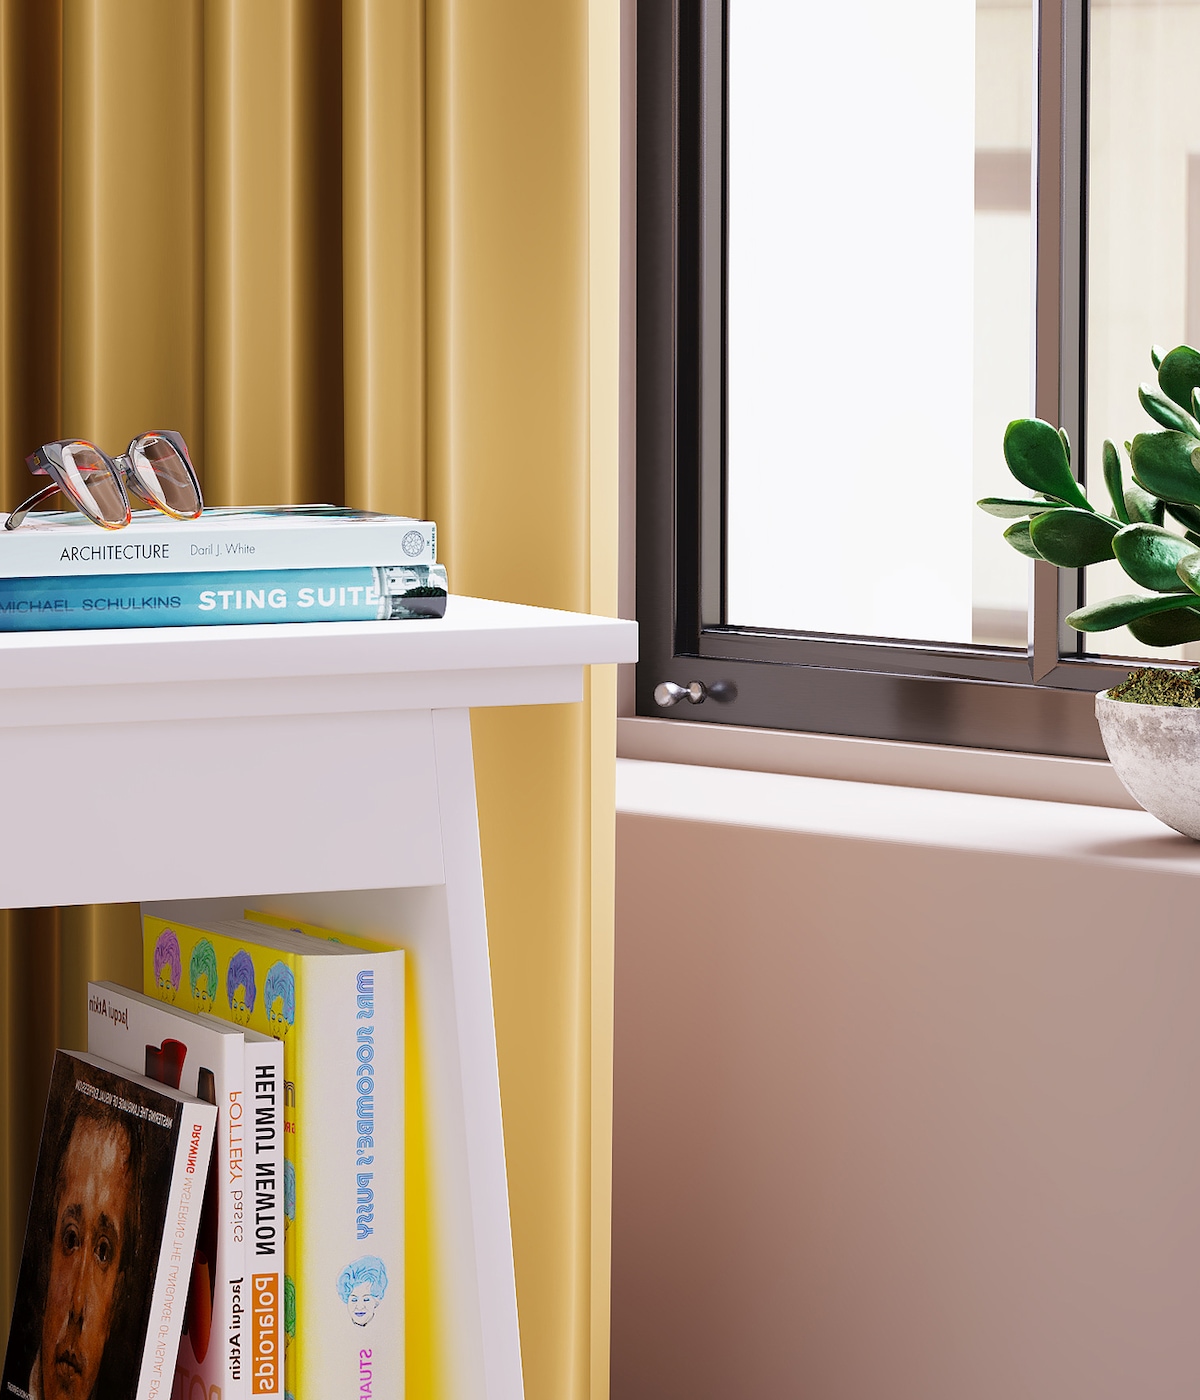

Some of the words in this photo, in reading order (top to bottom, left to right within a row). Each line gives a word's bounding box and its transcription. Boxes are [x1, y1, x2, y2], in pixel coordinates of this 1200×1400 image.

[60, 544, 169, 561] ARCHITECTURE
[190, 543, 213, 556] Daril
[215, 544, 222, 557] J.
[225, 542, 256, 554] White
[82, 596, 181, 611] SCHULKINS
[198, 588, 287, 611] STING
[297, 585, 379, 608] SUITE
